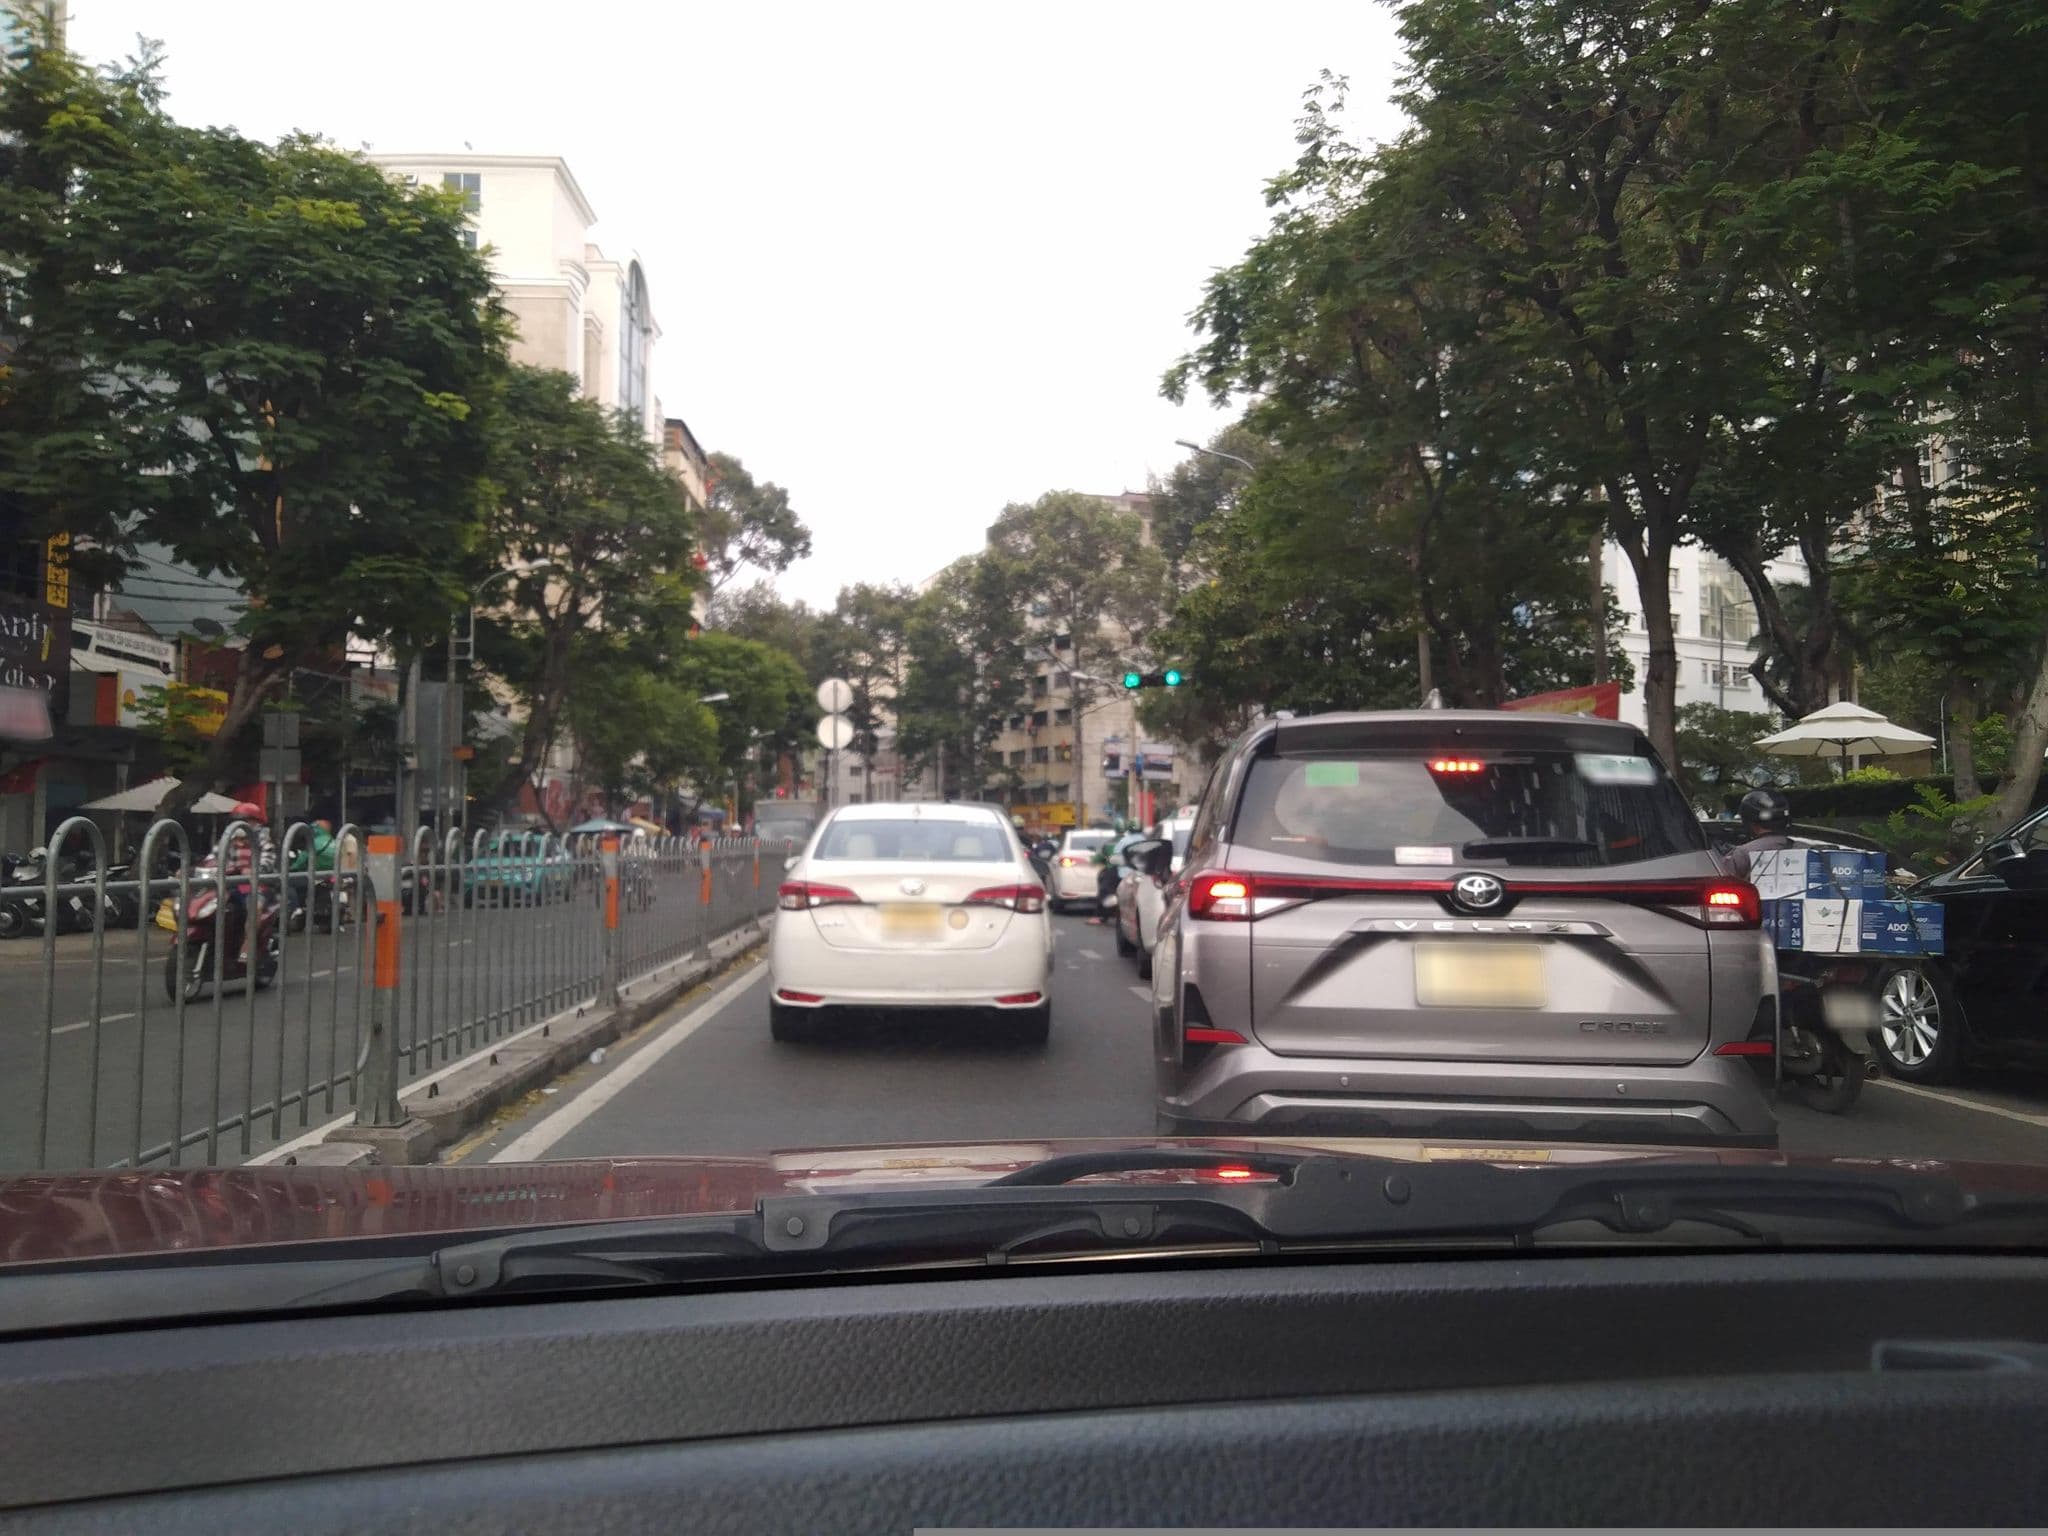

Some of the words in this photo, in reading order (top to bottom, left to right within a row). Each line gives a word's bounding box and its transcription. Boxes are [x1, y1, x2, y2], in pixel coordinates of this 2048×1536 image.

[1832, 867, 1852, 875] ADO
[1393, 920, 1569, 933] VELOZ
[1887, 923, 1908, 932] ADO
[1578, 1020, 1668, 1034] CROSS
